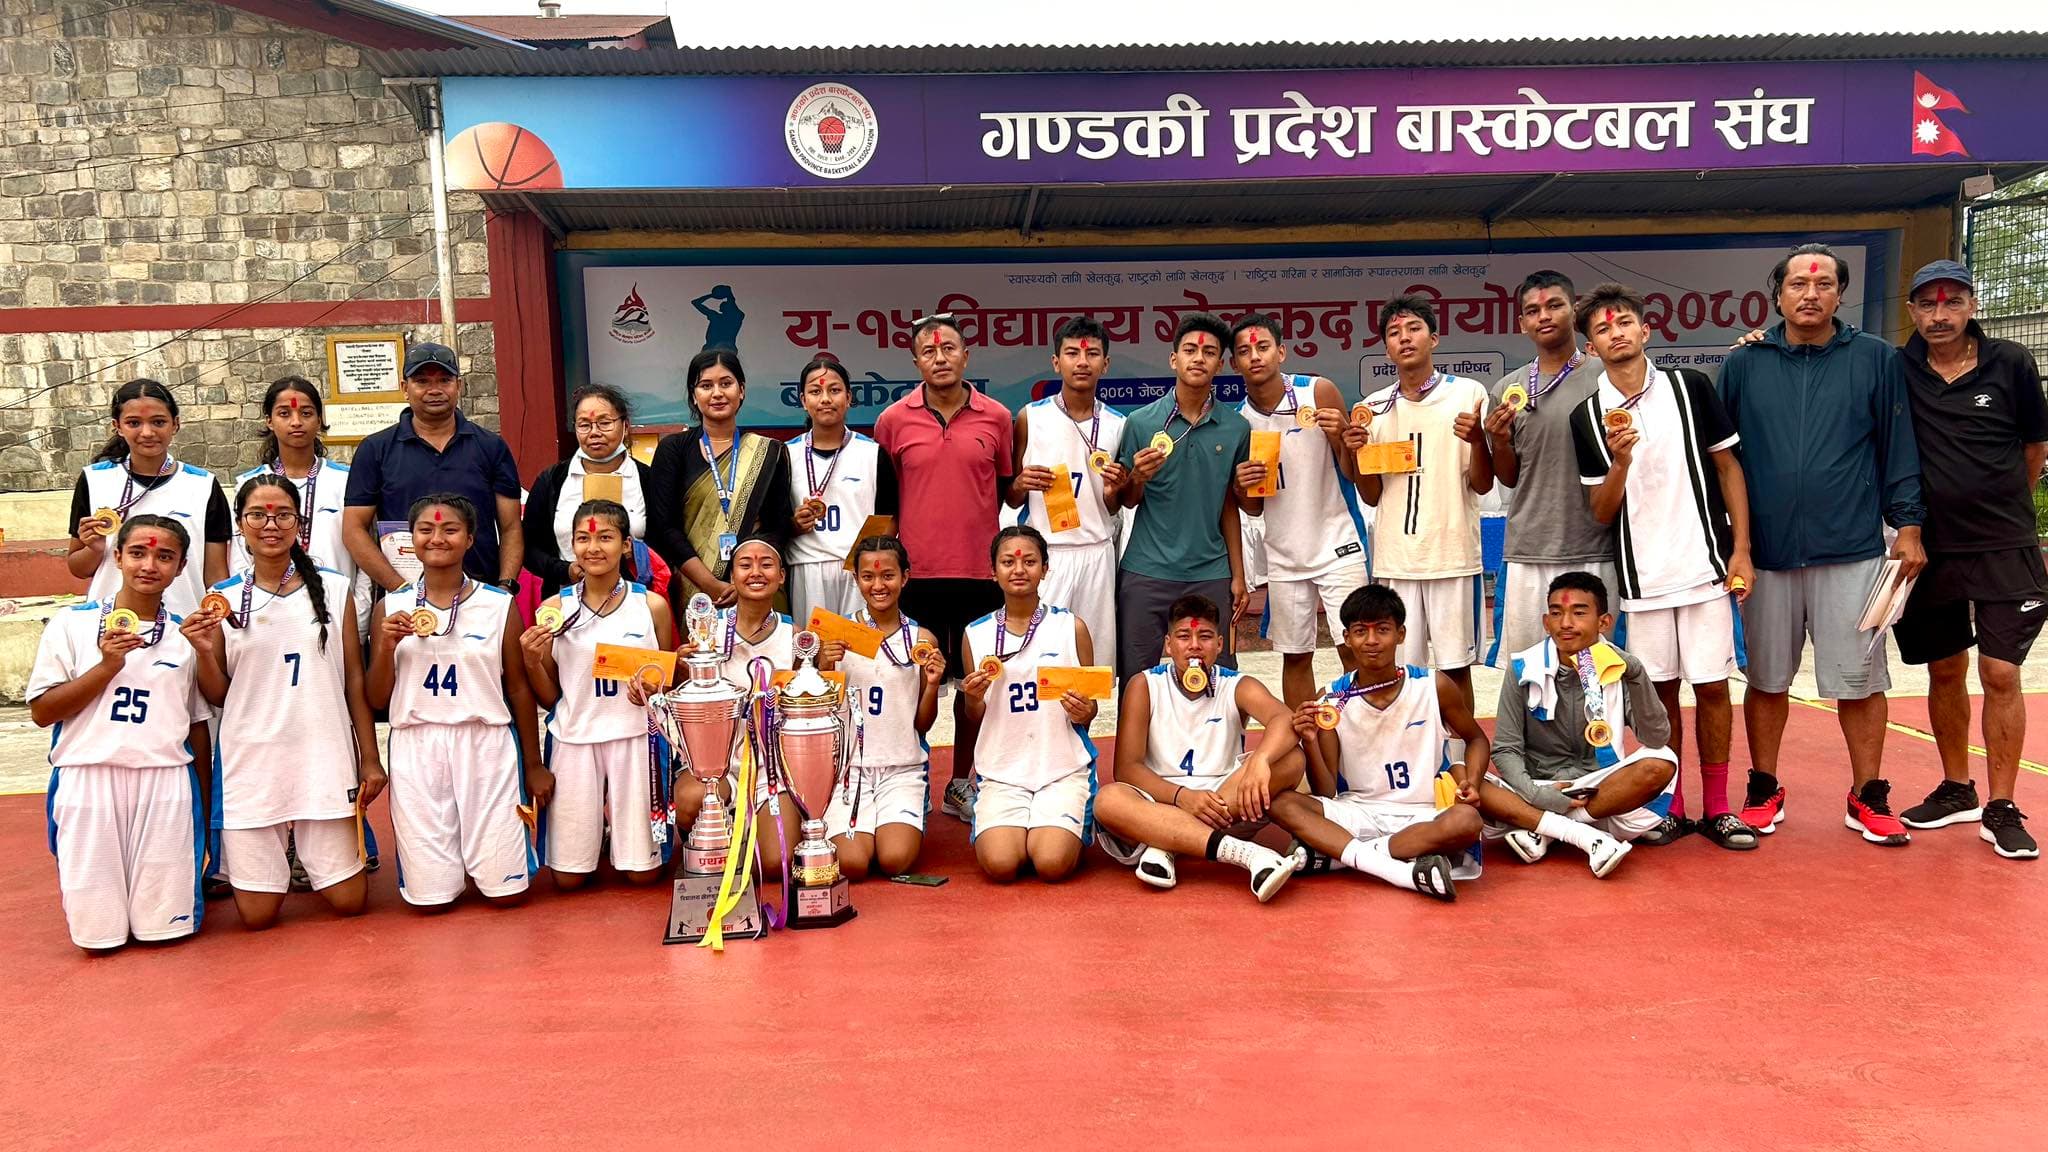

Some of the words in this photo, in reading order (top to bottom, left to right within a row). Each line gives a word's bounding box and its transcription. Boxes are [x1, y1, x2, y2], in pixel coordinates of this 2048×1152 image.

[980, 93, 1210, 160] गण्डकी
[1229, 91, 1377, 164] प्रदेश
[1396, 88, 1696, 156] बास्केटबल
[1714, 88, 1815, 150] संघ
[798, 152, 823, 173] PROVINCE
[823, 162, 859, 175] BASKETBALL
[857, 129, 875, 164] ASSOCIATION
[1644, 291, 1769, 343] २०८०
[1453, 360, 1492, 376] परिषद्
[1100, 387, 1133, 401] २०८१
[284, 652, 301, 687] 7
[422, 663, 458, 697] 44
[110, 686, 150, 724] 25
[868, 686, 883, 716] 9
[1008, 681, 1039, 713] 23
[1179, 748, 1194, 777] 4
[1384, 761, 1410, 790] 13
